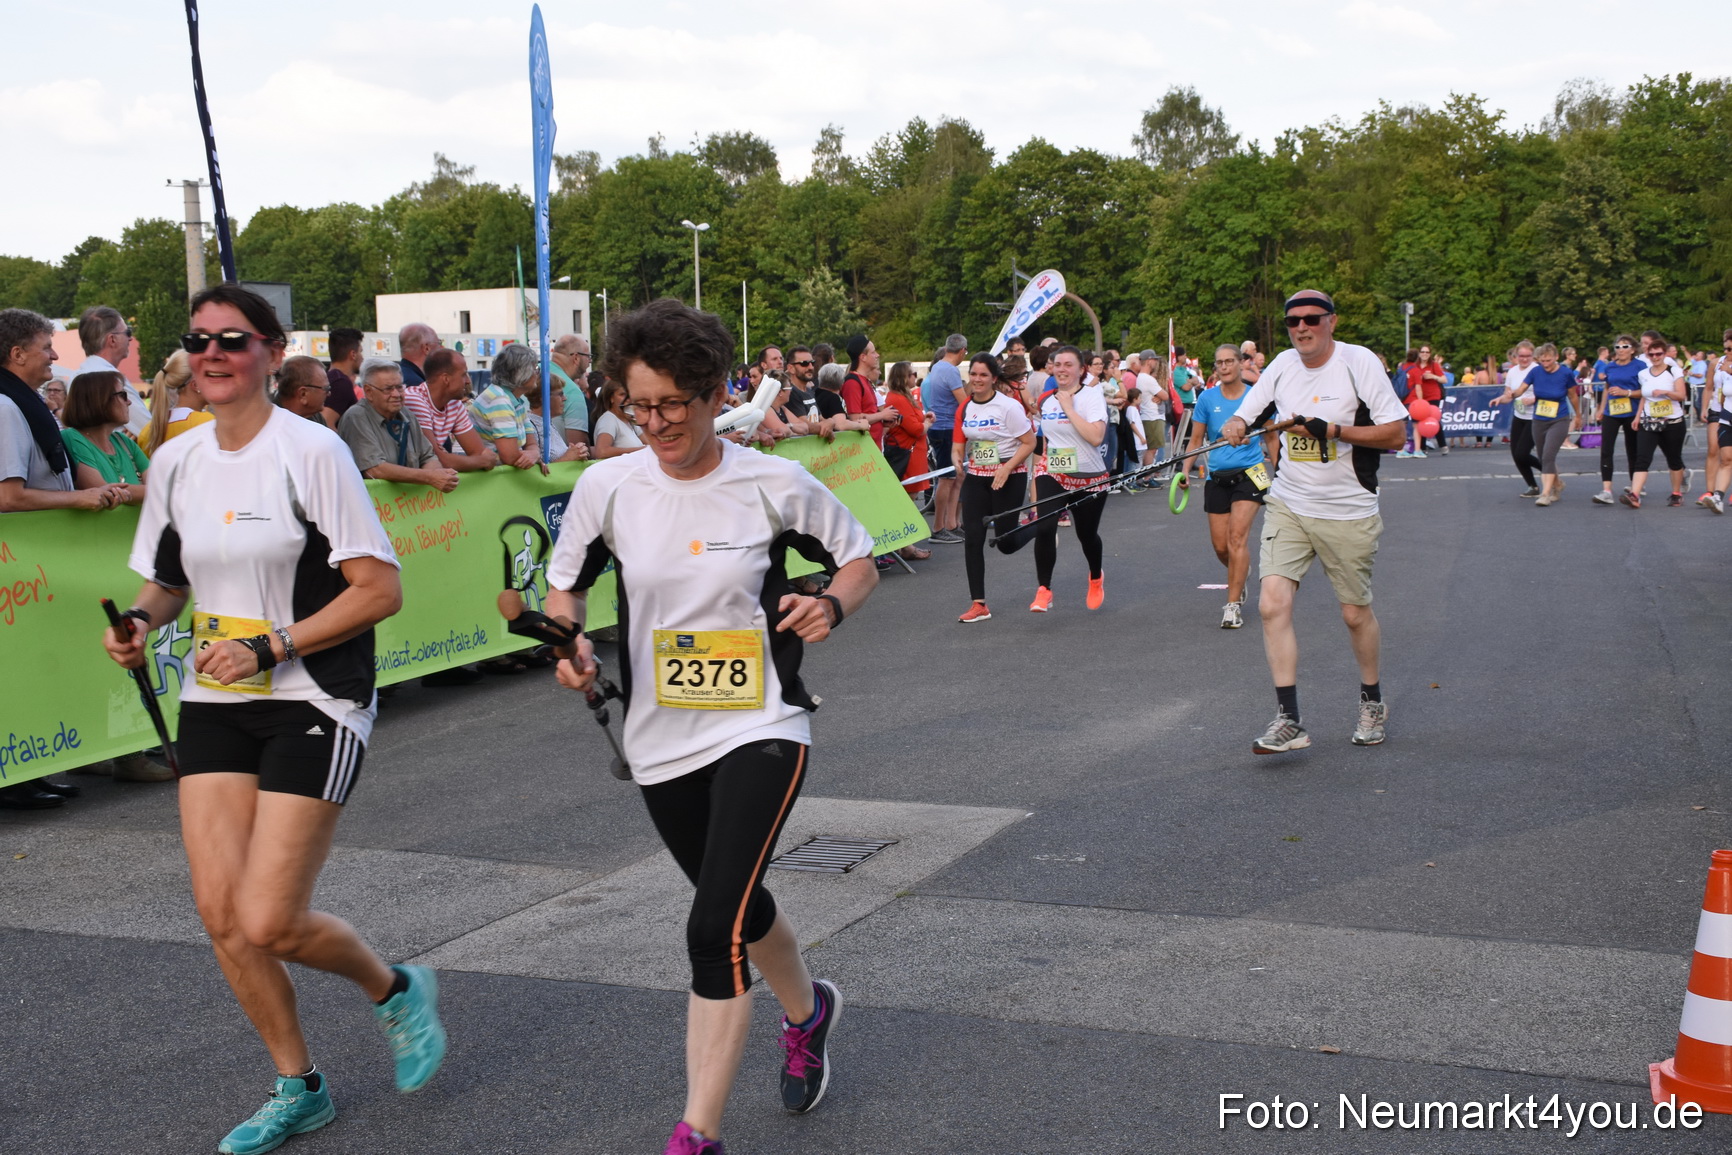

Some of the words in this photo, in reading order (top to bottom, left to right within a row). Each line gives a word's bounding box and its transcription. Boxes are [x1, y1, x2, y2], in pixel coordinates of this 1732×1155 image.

[1441, 407, 1500, 423] scher
[974, 449, 995, 460] 2062
[1291, 436, 1321, 451] 237
[1050, 456, 1072, 467] 2061
[414, 508, 469, 553] länger!
[873, 521, 918, 550] erpfalz.de
[0, 564, 54, 626] ger!
[373, 623, 488, 672] enlauf-oberpfalz.de
[666, 658, 748, 687] 2378
[0, 720, 82, 780] pfalz.de
